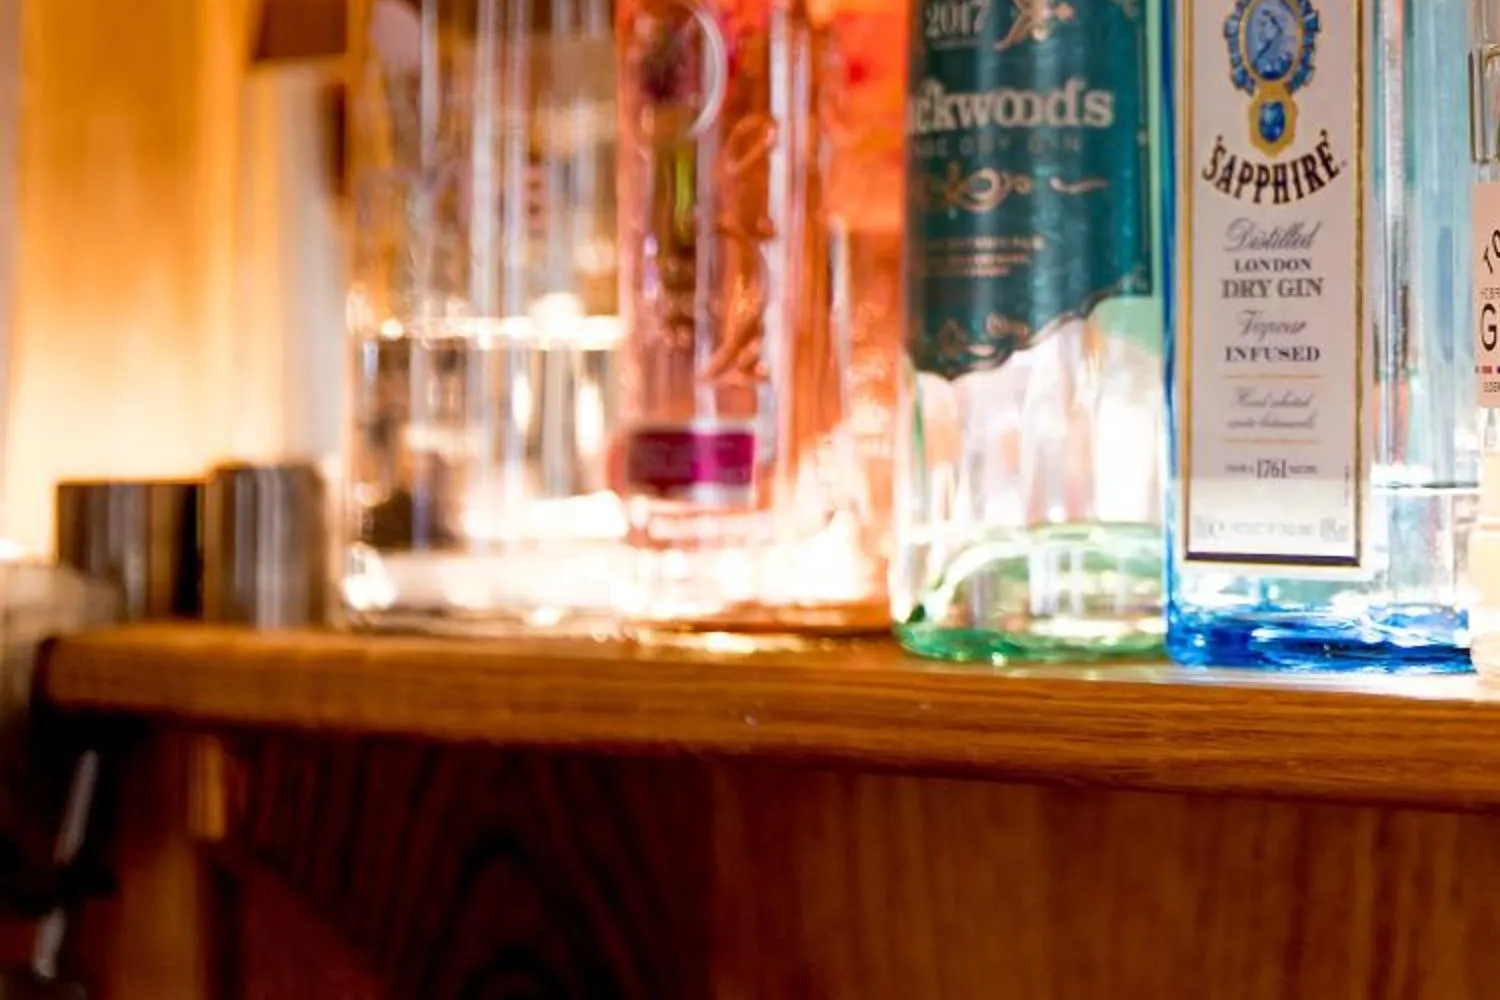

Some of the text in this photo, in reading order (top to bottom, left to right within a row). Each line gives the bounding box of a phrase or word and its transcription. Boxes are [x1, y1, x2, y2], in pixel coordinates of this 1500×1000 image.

[1201, 133, 1341, 204] SAPPHIRE
[1223, 216, 1323, 251] Distilled
[1234, 257, 1313, 274] LONDON
[1221, 277, 1324, 300] DRY GIN
[1225, 345, 1321, 364] INFUSED
[1256, 459, 1287, 479] 1761
